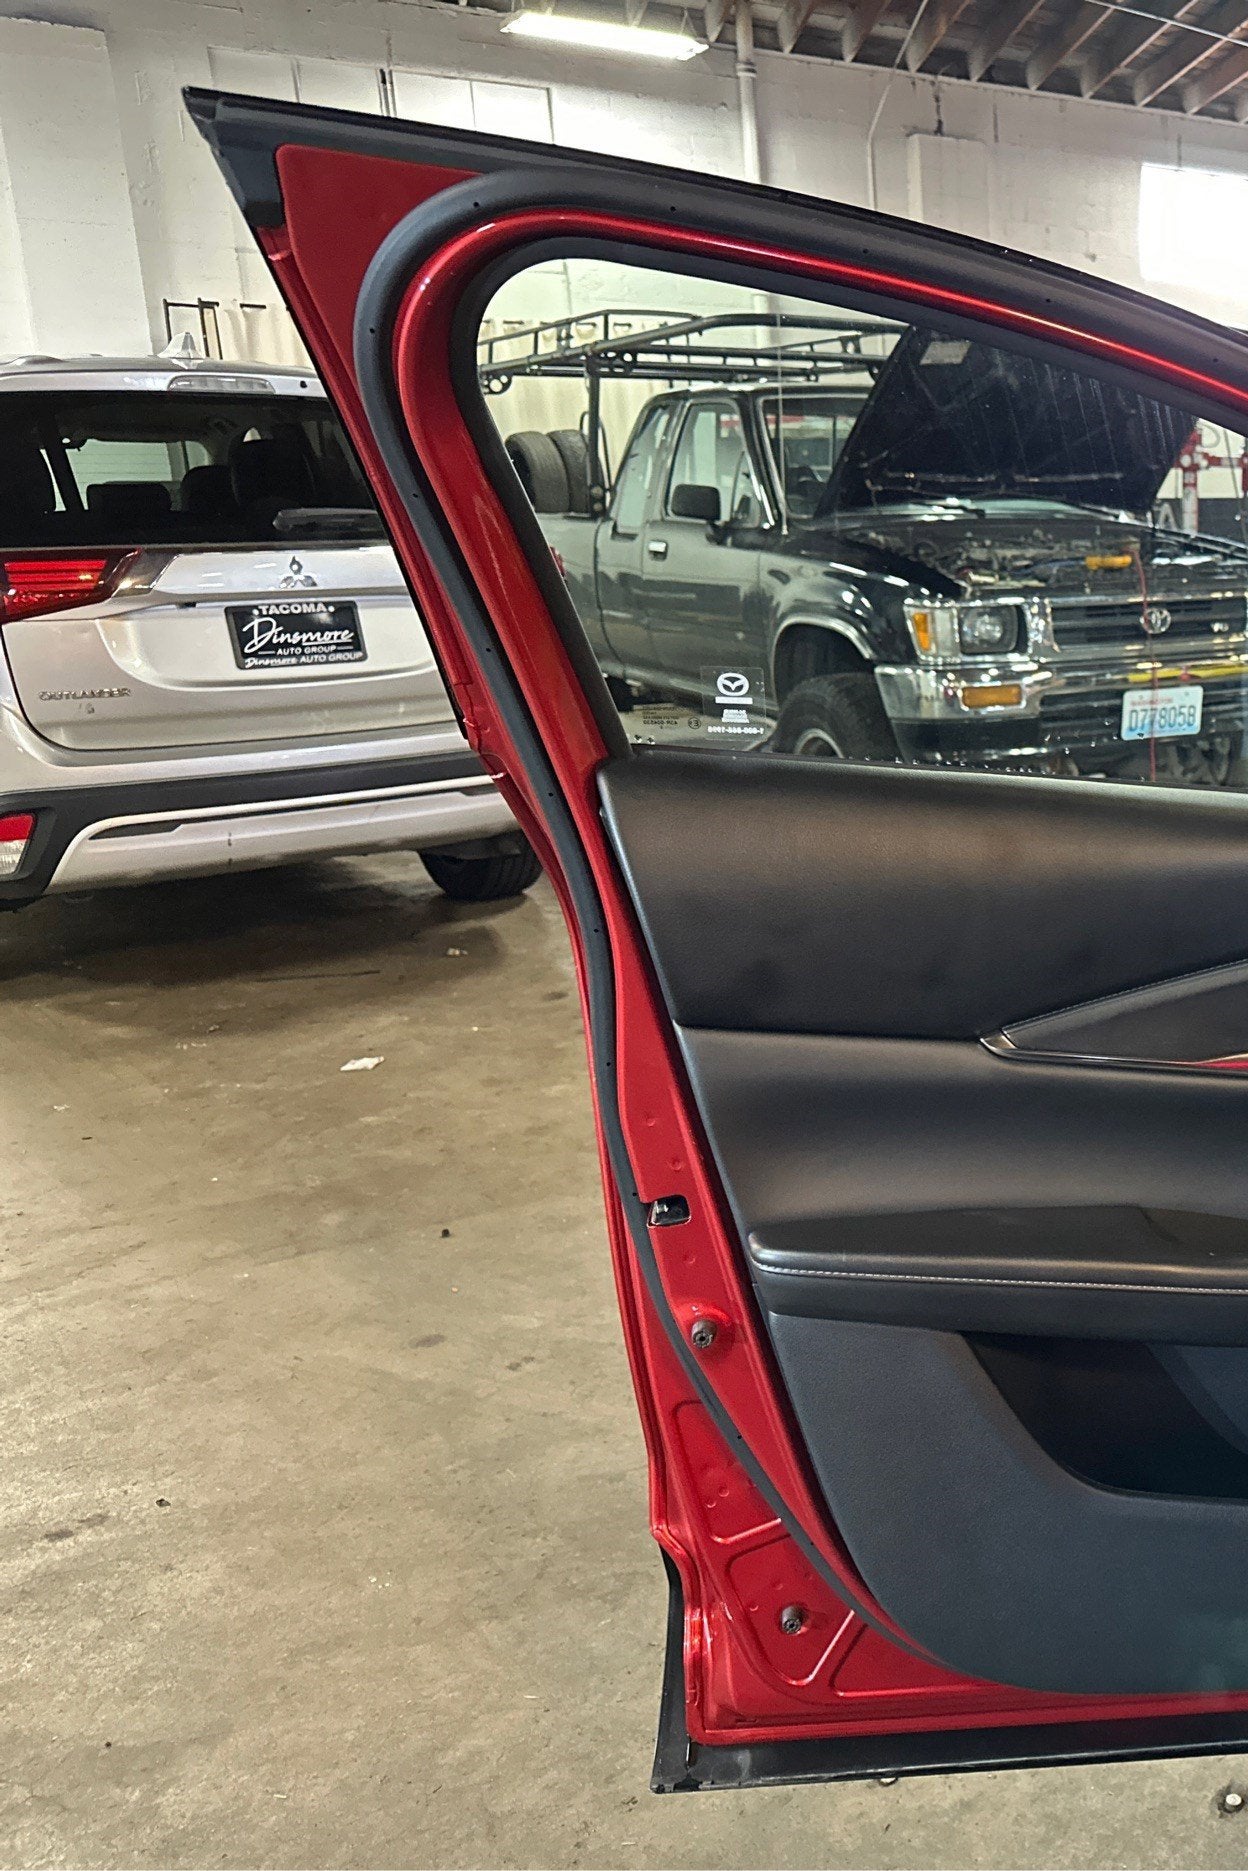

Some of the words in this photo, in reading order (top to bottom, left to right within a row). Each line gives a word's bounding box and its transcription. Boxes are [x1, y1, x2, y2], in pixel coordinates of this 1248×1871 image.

[258, 602, 327, 615] TACOMA
[242, 617, 354, 654] Dinsmore
[277, 647, 301, 656] AUTO
[304, 645, 337, 654] GROUP
[300, 655, 326, 663] AUTO
[328, 651, 363, 661] GROUP
[39, 687, 131, 701] OUTLANDER
